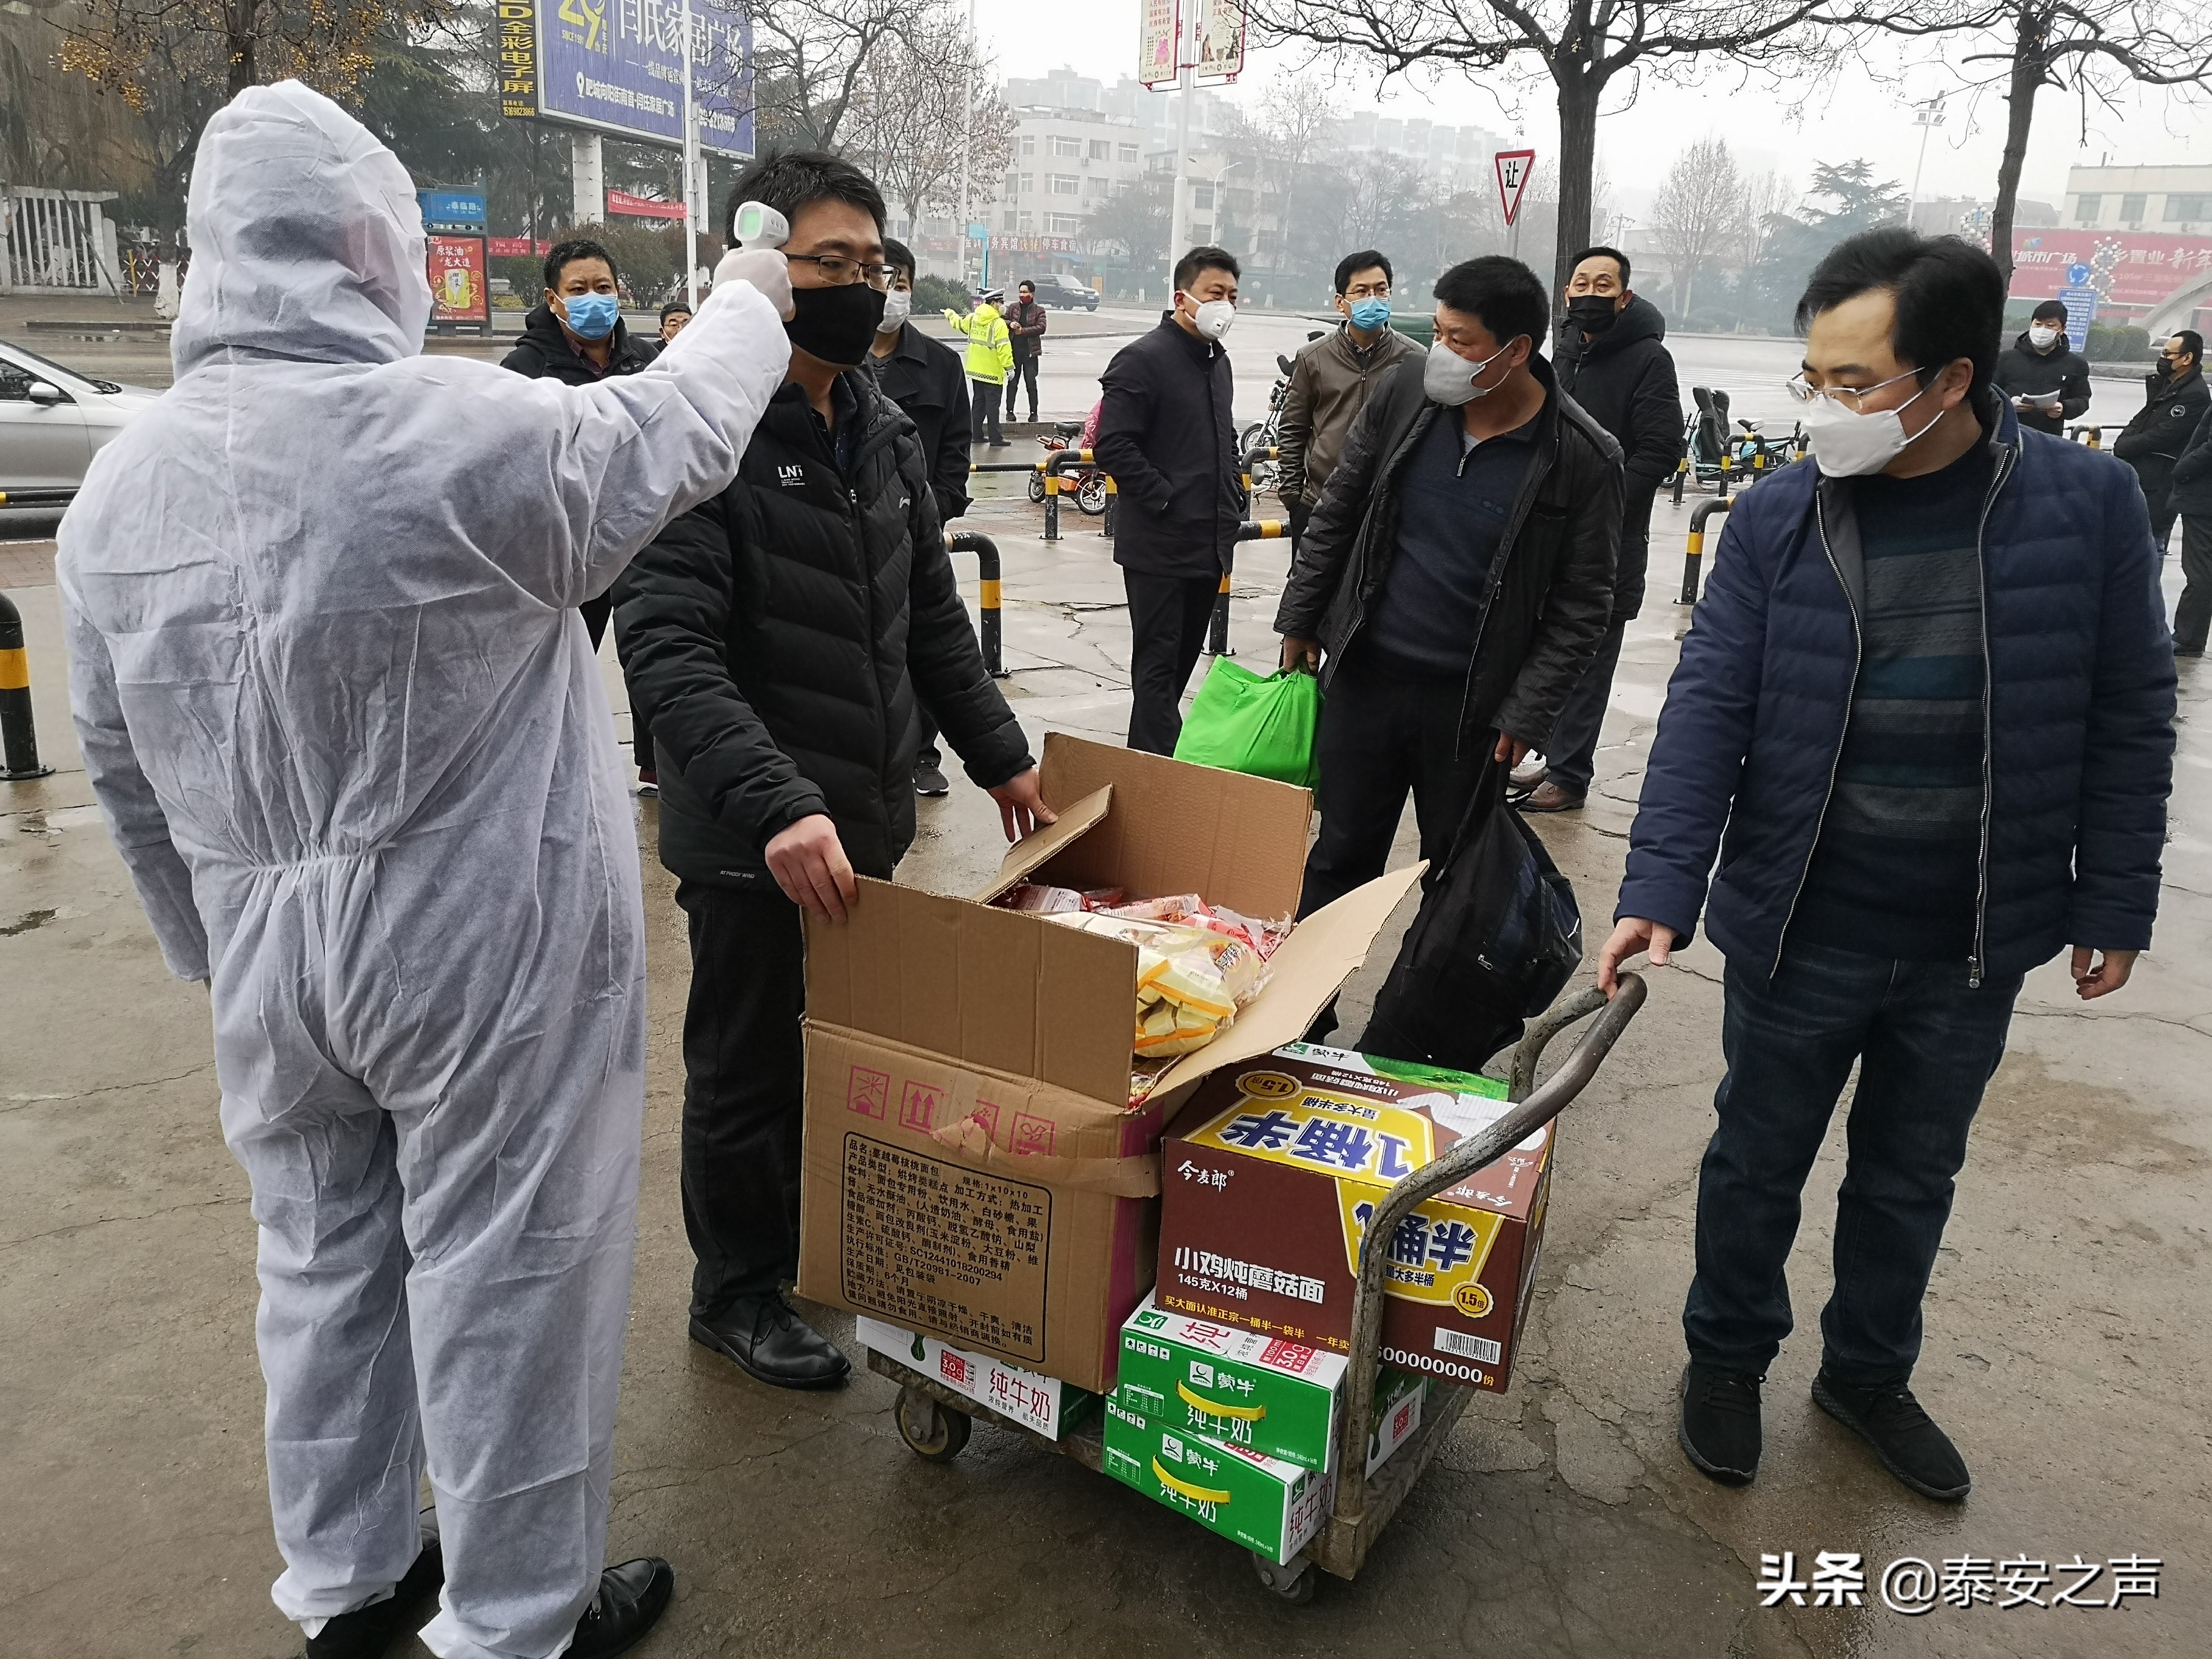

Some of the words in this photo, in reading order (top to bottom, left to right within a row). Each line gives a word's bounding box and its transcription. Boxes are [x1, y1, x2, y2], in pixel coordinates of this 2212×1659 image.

[499, 0, 534, 93] D全彩电子屏
[561, 30, 574, 41] SINCE
[504, 107, 535, 116] 15169823866
[1506, 161, 1518, 189] 让
[436, 245, 464, 256] 原浆油
[1042, 238, 1077, 252] 停车食宿
[2012, 250, 2077, 264] 城市广场
[1250, 1077, 1290, 1093] 1.5倍
[1302, 1097, 1380, 1119] 量大多半桶
[1220, 1111, 1413, 1179] 1桶半
[1178, 1160, 1227, 1193] 今麦郎
[1175, 1247, 1325, 1304] 小鸡炖蘑菇面
[1178, 1273, 1248, 1301] 145克X12桶
[1460, 1291, 1485, 1309] 1.5倍
[1164, 1295, 1305, 1339] 买大面认准正宗一桶半一袋半
[942, 1358, 963, 1379] 3.0g
[990, 1368, 1050, 1422] 纯牛奶
[1218, 1372, 1253, 1398] 蒙牛
[988, 1395, 1014, 1414] 浓纯营养
[1022, 1412, 1049, 1432] 航天品质
[1186, 1449, 1218, 1477] 蒙牛
